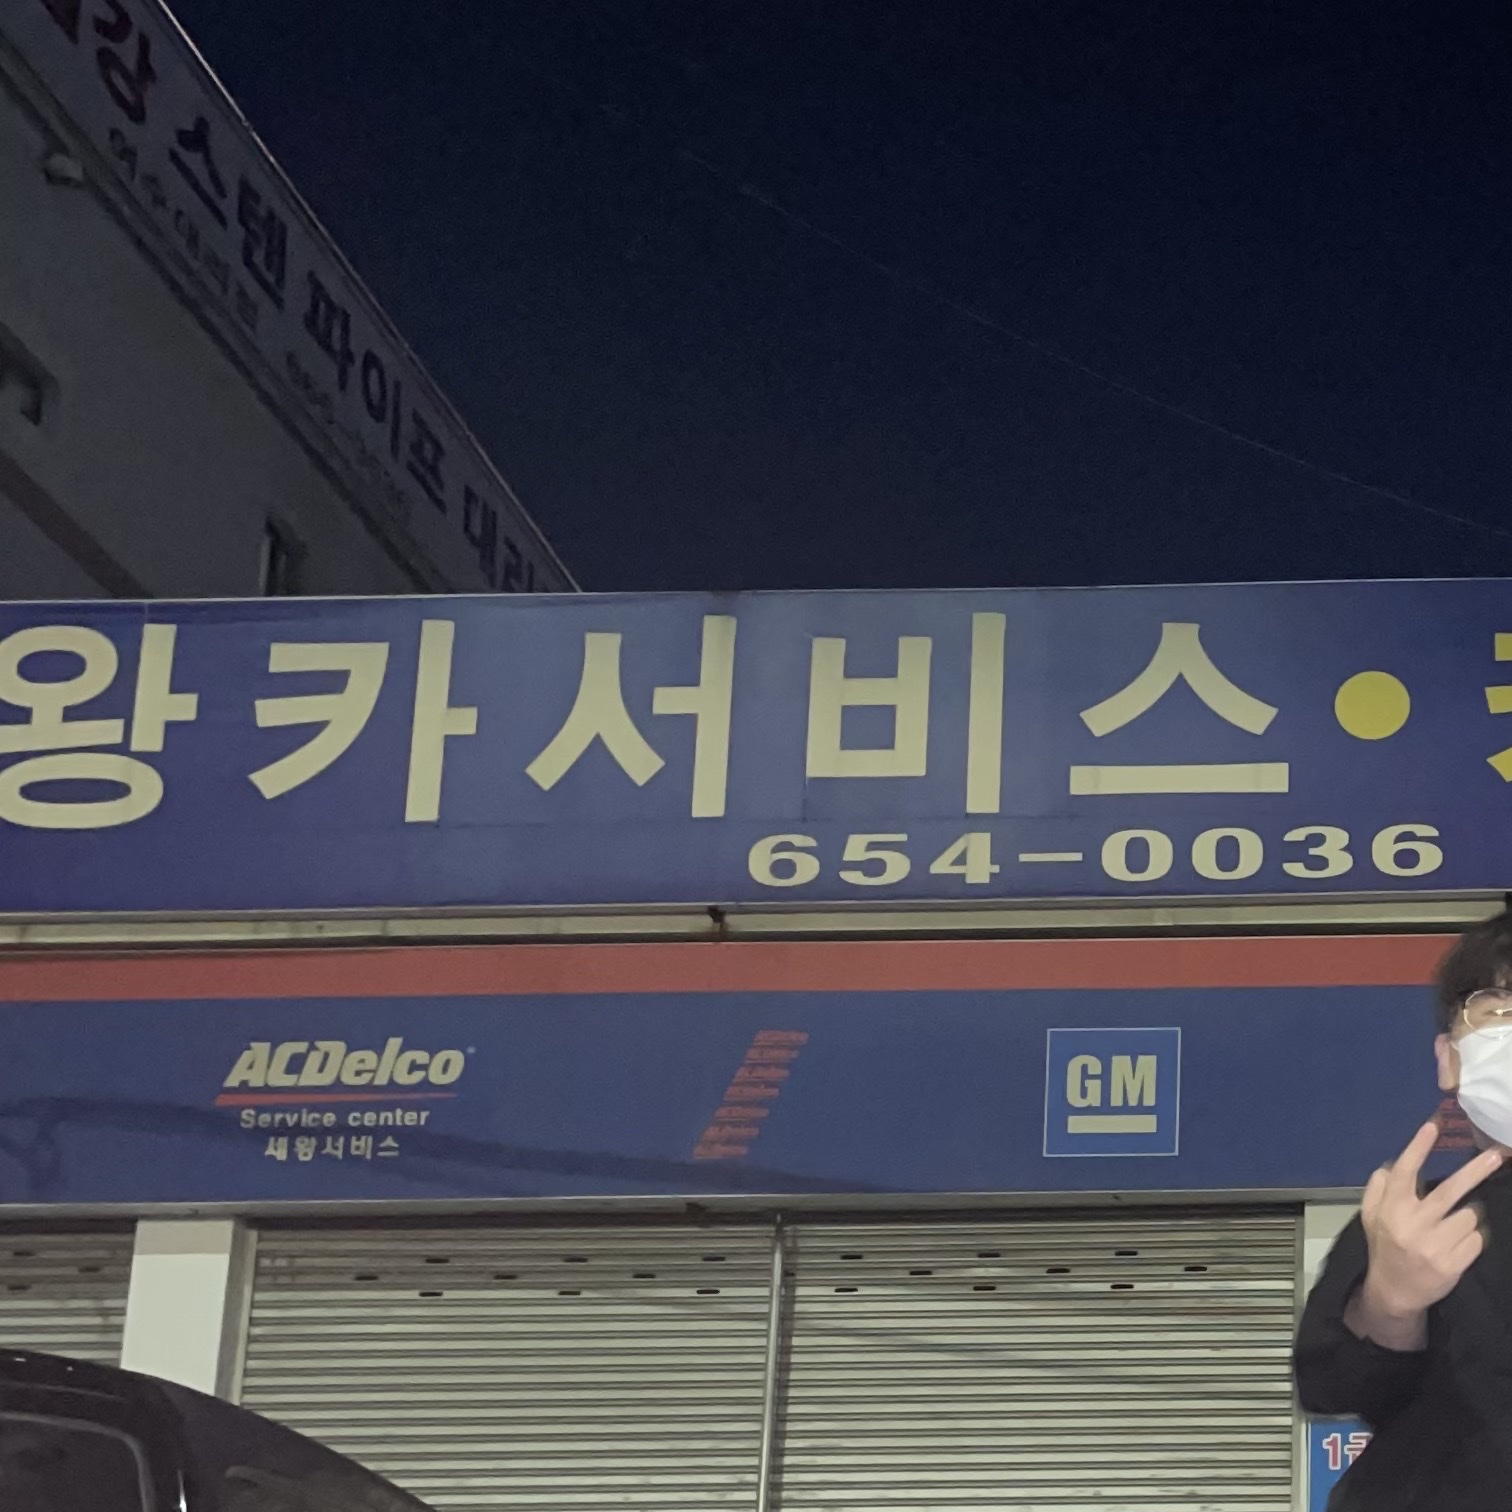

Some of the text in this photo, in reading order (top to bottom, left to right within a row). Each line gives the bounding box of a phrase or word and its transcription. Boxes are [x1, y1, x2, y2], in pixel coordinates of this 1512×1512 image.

[747, 823, 1444, 887] 654-0036
[223, 1037, 466, 1088] ACDelco
[1066, 1055, 1158, 1108] GM
[240, 1107, 430, 1129] Service center
